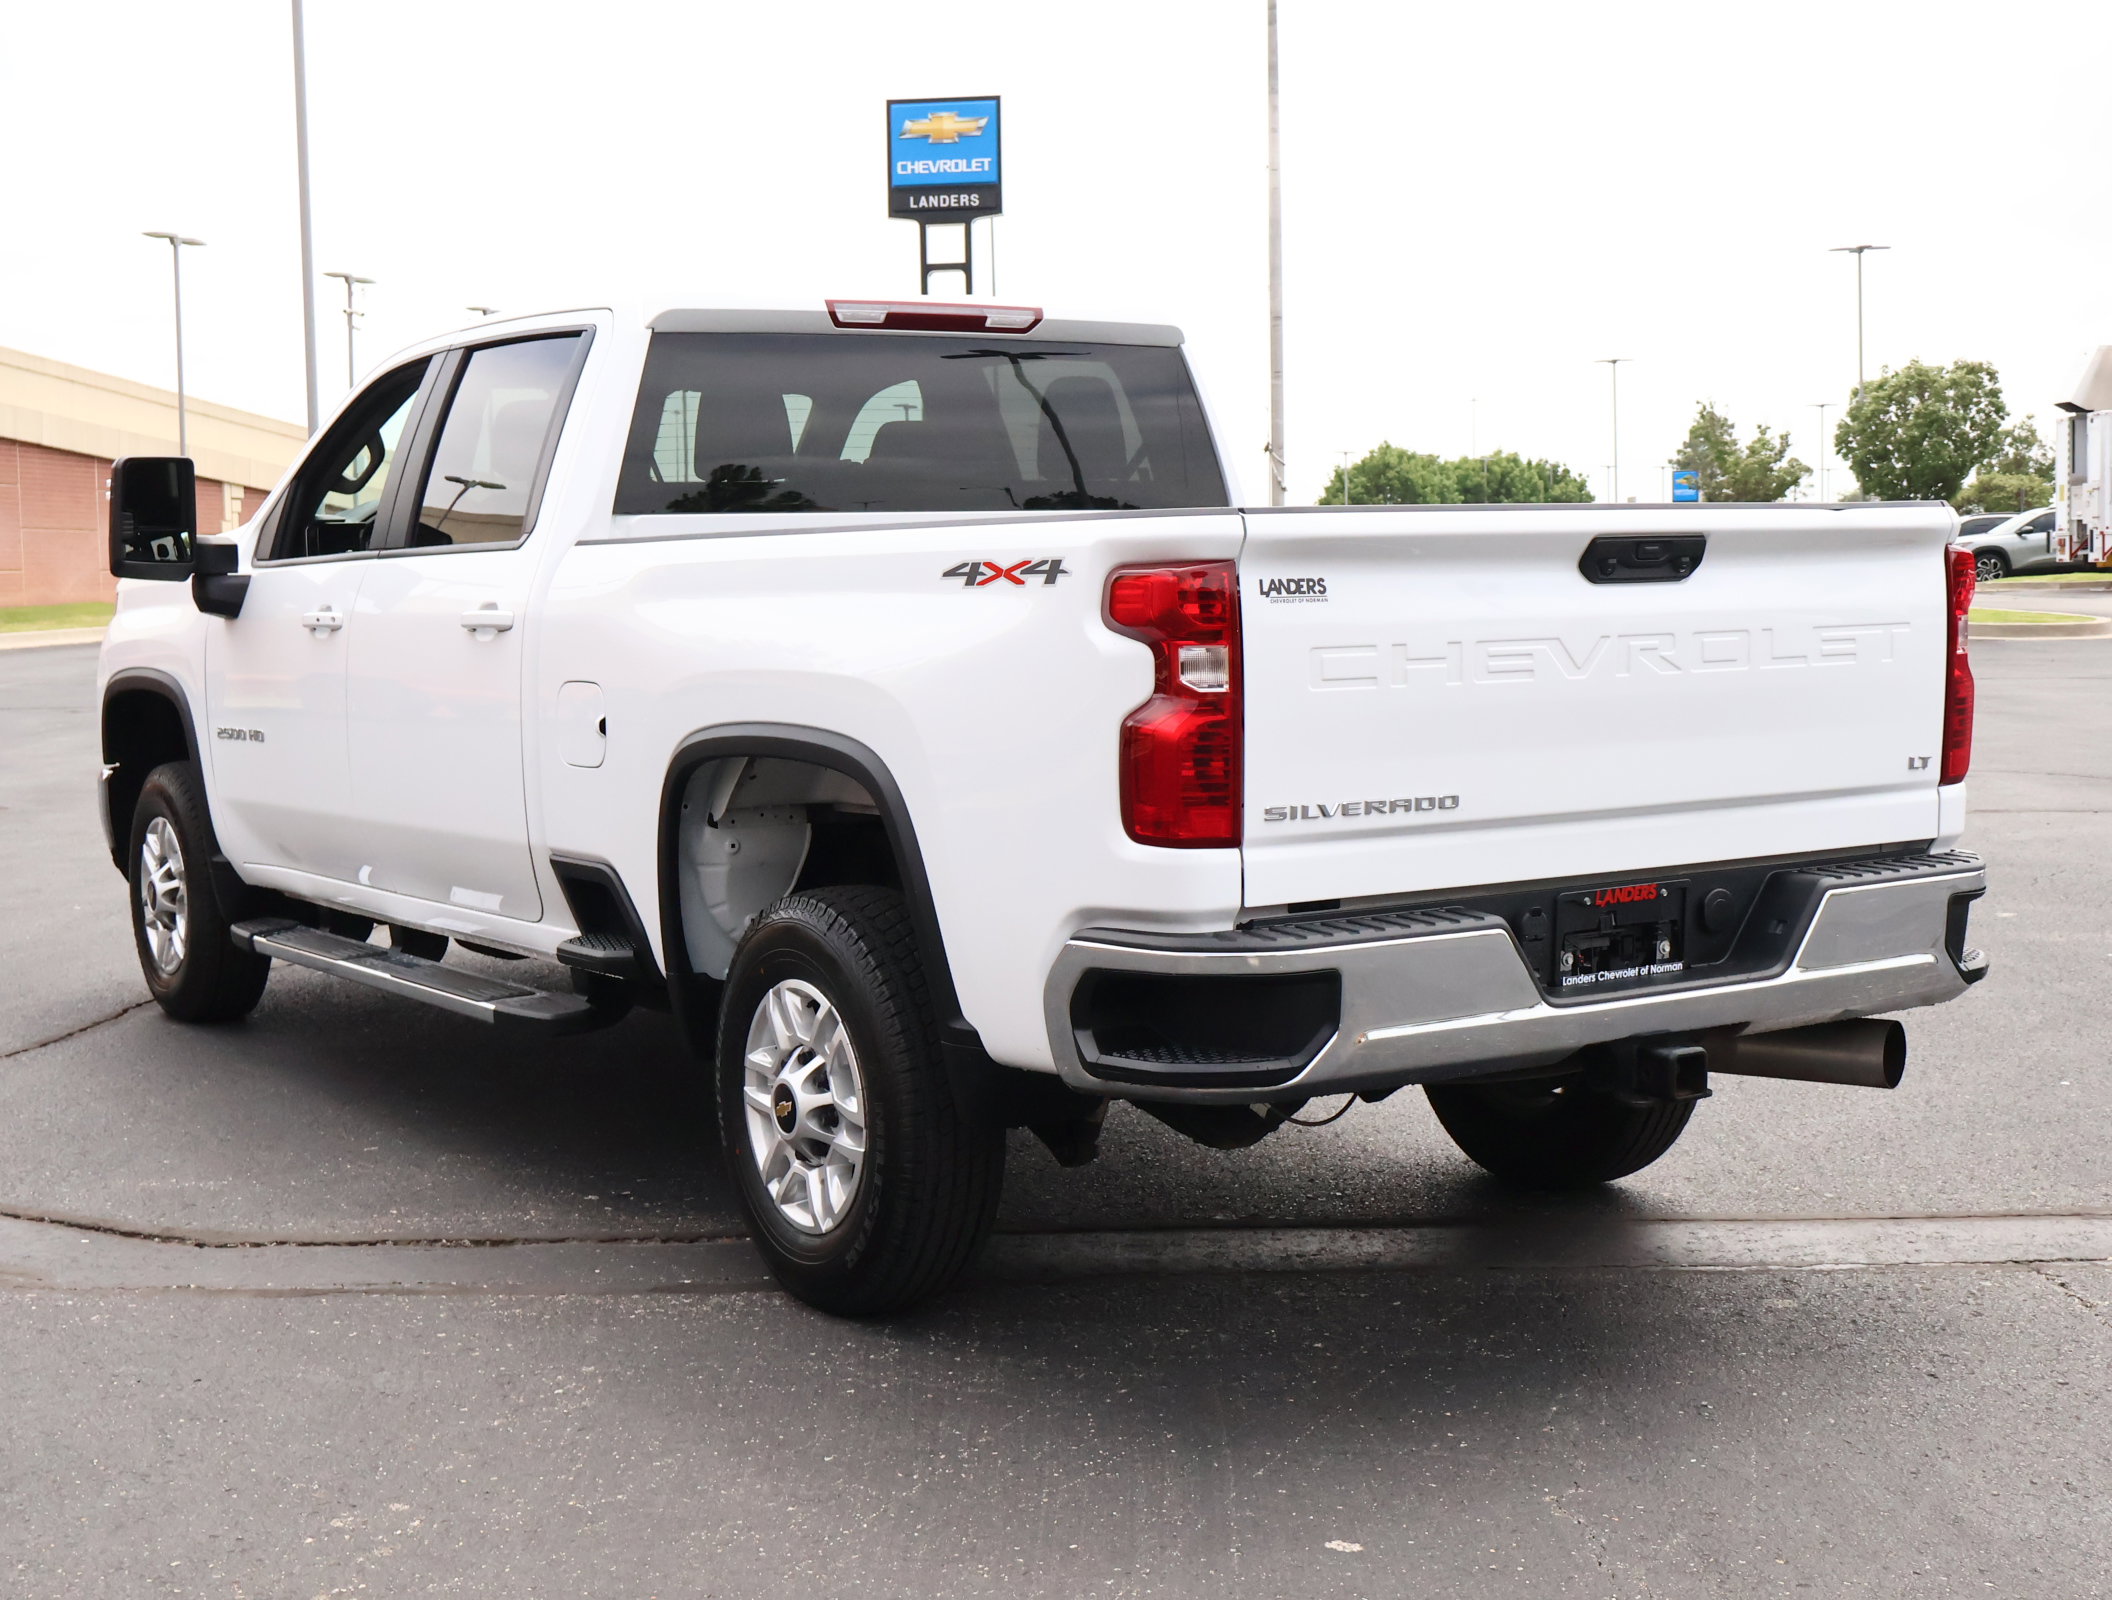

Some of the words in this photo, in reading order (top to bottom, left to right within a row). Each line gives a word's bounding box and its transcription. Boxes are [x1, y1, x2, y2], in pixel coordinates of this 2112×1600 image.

[897, 158, 992, 175] CHEVROLET
[909, 193, 980, 209] LANDERS
[1258, 577, 1327, 598] LANDERS
[1309, 622, 1911, 692] CHEVROLET
[217, 727, 247, 741] 2500
[248, 729, 265, 743] HD
[1908, 756, 1932, 770] LT
[1264, 794, 1460, 823] SILVERADO
[1595, 883, 1659, 907] LANDERS
[1562, 975, 1596, 986] Landers
[1597, 968, 1638, 982] Chevrolet
[1640, 965, 1649, 975] of
[1650, 962, 1683, 974] Norman
